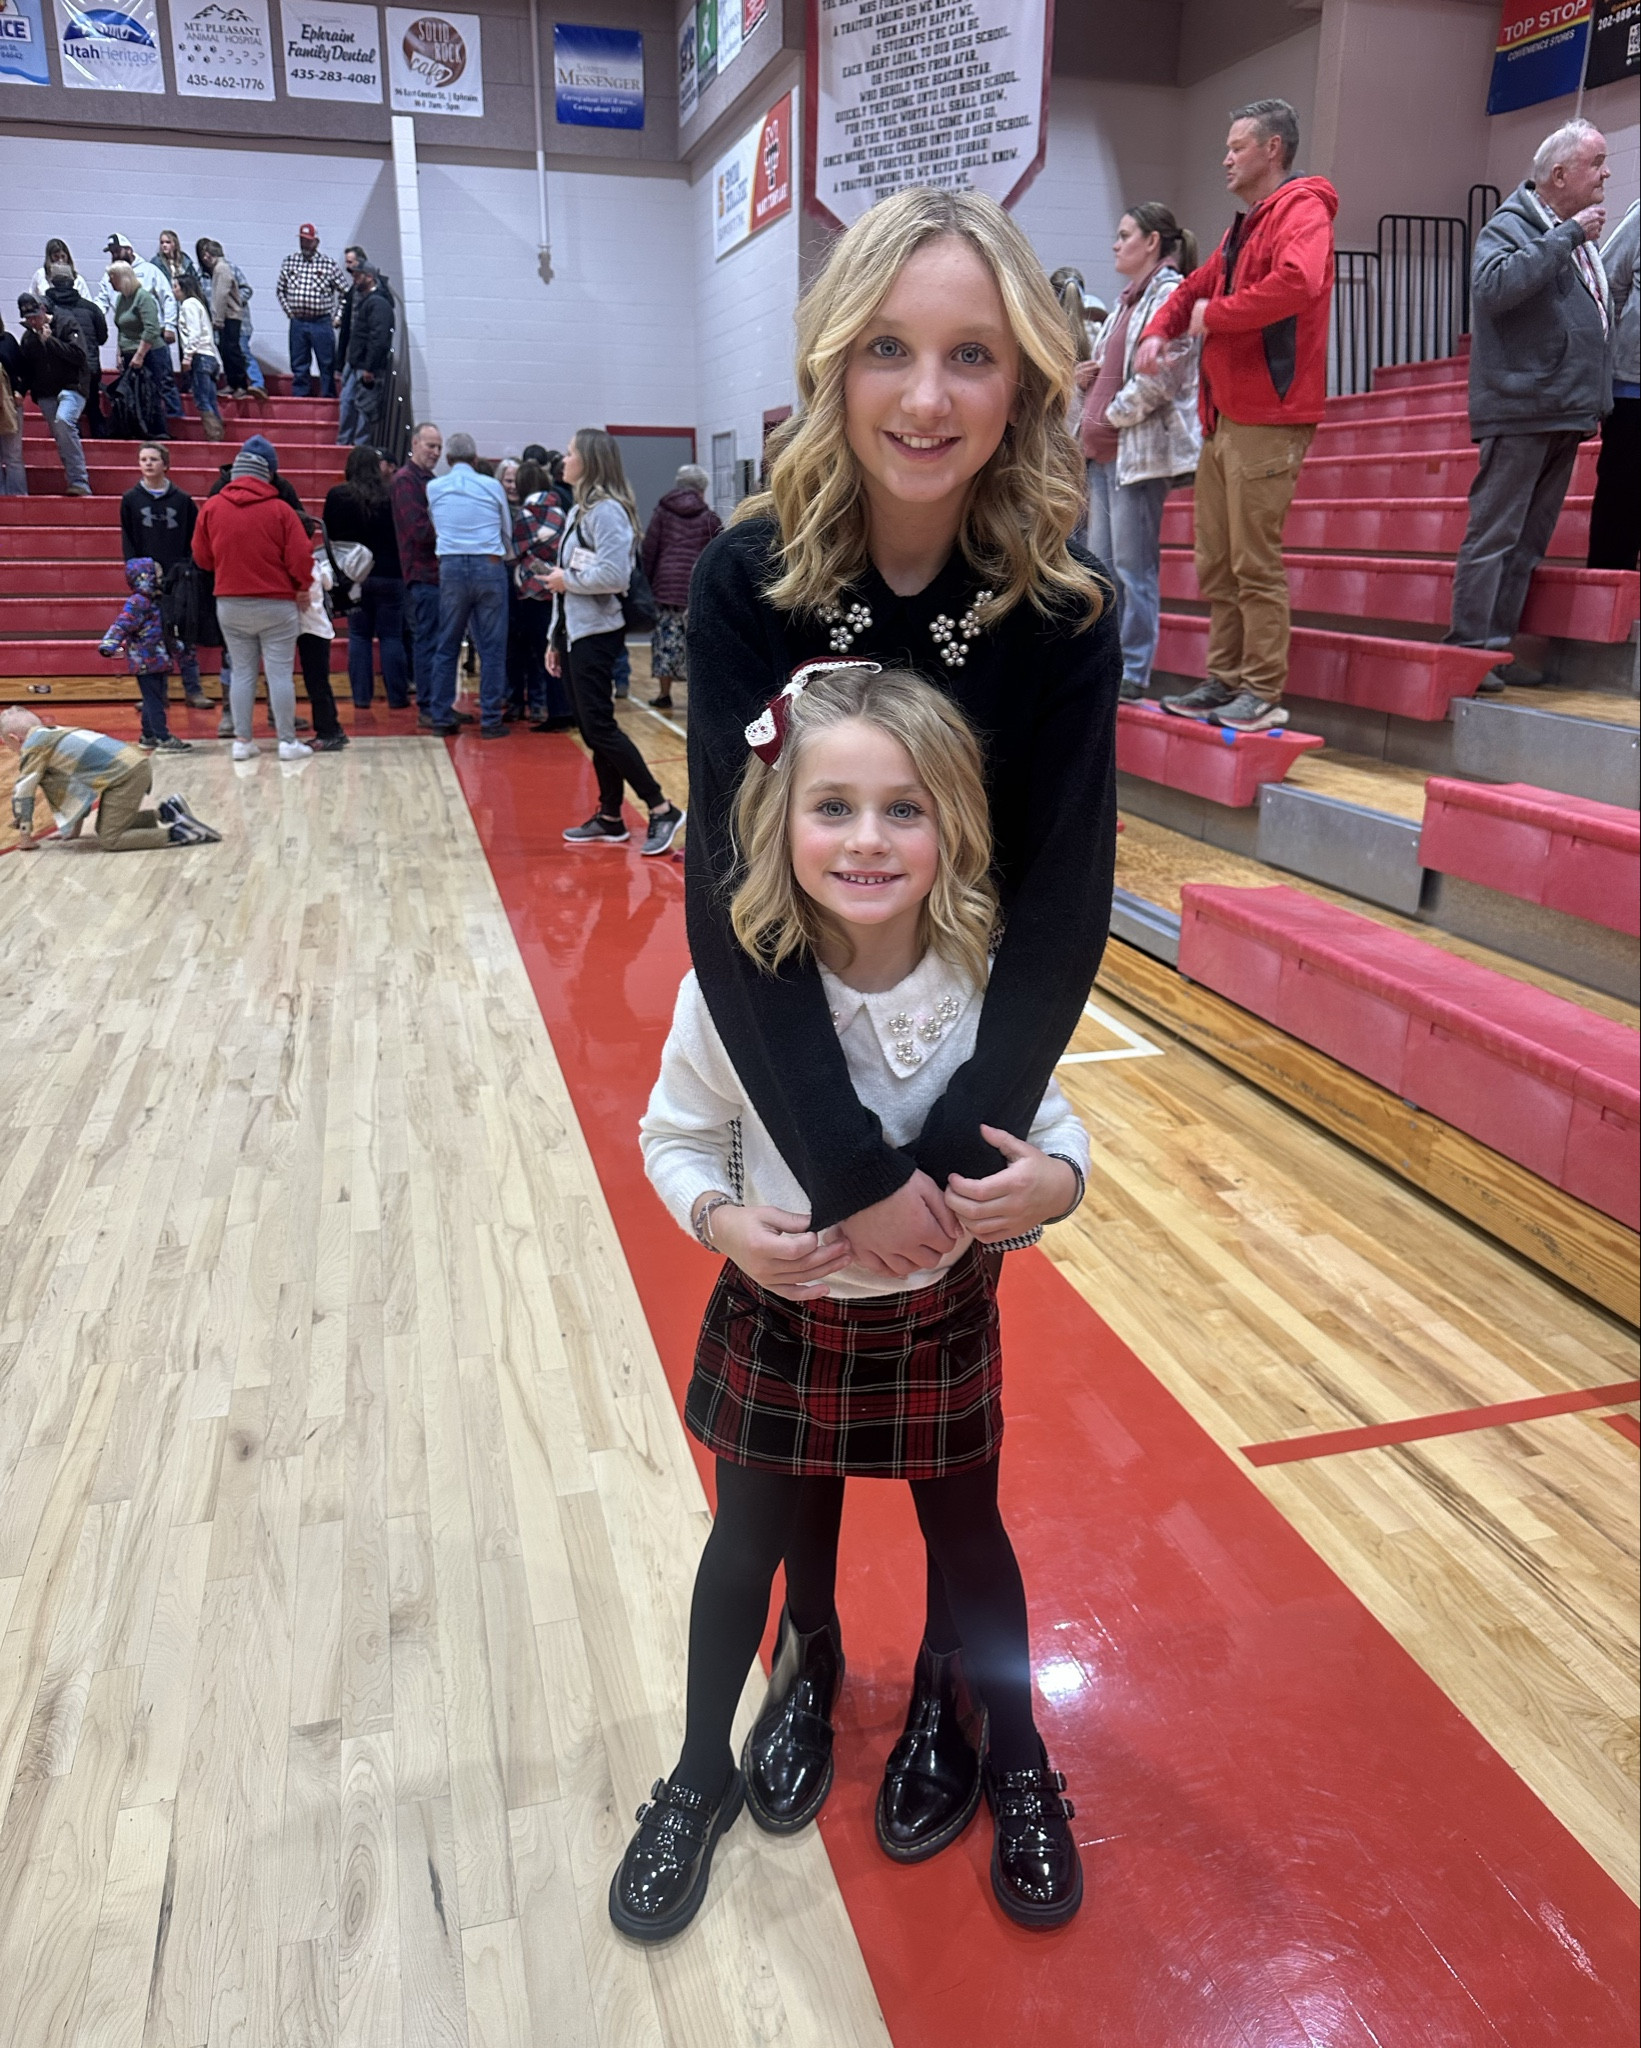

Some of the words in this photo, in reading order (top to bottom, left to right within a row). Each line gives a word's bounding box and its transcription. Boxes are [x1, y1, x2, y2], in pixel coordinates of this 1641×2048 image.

[184, 22, 203, 32] MT.
[205, 23, 261, 36] PLEASANT
[301, 23, 355, 44] Ephraim
[418, 20, 450, 43] SOLID
[833, 26, 838, 37] A
[841, 16, 873, 35] TRAITOR
[875, 8, 904, 25] AMONG
[906, 4, 917, 17] US
[919, 0, 932, 13] WE
[876, 25, 898, 40] THEN
[900, 16, 927, 34] HAPPY
[929, 8, 957, 26] HAPPY
[1504, 16, 1535, 42] TOP
[1538, 0, 1587, 28] STOP
[186, 32, 220, 43] ANIMAL
[225, 35, 263, 46] HOSPITAL
[288, 40, 331, 63] Family
[331, 45, 377, 63] Dental
[871, 44, 881, 56] AS
[883, 32, 926, 53] STUDENTS
[949, 21, 965, 36] CAN
[968, 17, 980, 31] BE
[434, 42, 462, 64] ROCK
[843, 63, 862, 78] EACH
[865, 56, 890, 72] HEART
[892, 50, 918, 66] LOYAL
[921, 45, 932, 58] TO
[934, 41, 949, 55] OUR
[952, 34, 973, 50] HIGH
[884, 62, 926, 82] STUDENTS
[928, 55, 952, 72] FROM
[186, 73, 265, 90] 435-462-1776
[290, 68, 377, 85] 435-283-4081
[559, 66, 641, 90] MESSENGER
[859, 89, 878, 102] WHO
[879, 80, 911, 98] BEHOLD
[914, 76, 930, 90] THE
[932, 68, 964, 86] BEACON
[834, 106, 867, 123] QUICKLY
[869, 101, 890, 116] THEY
[892, 94, 915, 110] COME
[917, 89, 938, 104] UNTO
[940, 84, 957, 99] OUR
[959, 79, 981, 95] HIGH
[845, 122, 859, 135] FOR
[861, 118, 875, 132] ITS
[877, 113, 898, 128] TRUE
[900, 106, 928, 122] WORTH
[930, 102, 947, 116] ALL
[949, 95, 978, 112] SHALL
[823, 153, 843, 168] ONCE
[845, 148, 866, 164] MORE
[868, 143, 894, 159] THREE
[896, 136, 928, 153] CHEERS
[930, 131, 952, 146] UNTO
[954, 127, 970, 141] OUR
[972, 121, 993, 137] HIGH
[853, 135, 862, 148] AS
[864, 131, 880, 145] THE
[883, 125, 907, 142] YEARS
[909, 120, 936, 135] SHALL
[938, 113, 963, 130] COME
[965, 109, 982, 124] AND
[833, 182, 838, 193] A
[841, 175, 872, 192] TRAITOR
[874, 170, 902, 186] AMONG
[904, 167, 914, 180] US
[917, 164, 930, 177] WE
[932, 159, 958, 175] NEVER
[961, 153, 989, 169] SHALL
